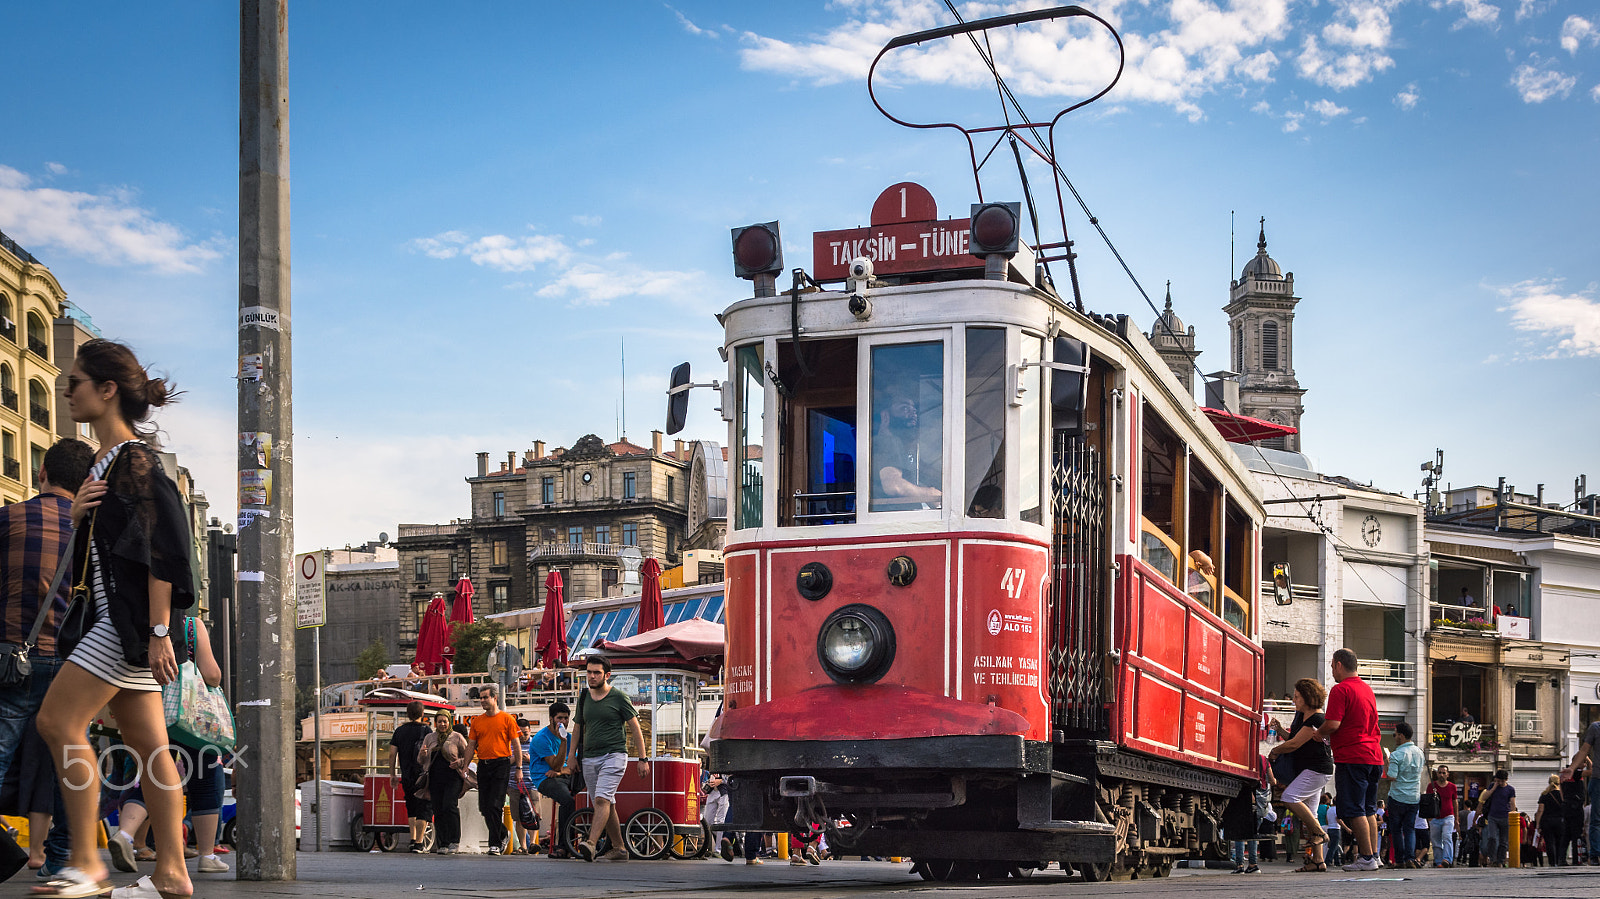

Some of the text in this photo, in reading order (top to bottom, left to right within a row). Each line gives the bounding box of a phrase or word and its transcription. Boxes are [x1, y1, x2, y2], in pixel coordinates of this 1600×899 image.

[898, 187, 907, 218] 1
[829, 231, 897, 266] TAKSİM
[919, 226, 971, 258] TÜNE
[244, 311, 277, 324] GÜNLÜK
[328, 581, 362, 593] AK-KA
[1000, 567, 1026, 599] 47
[1003, 622, 1020, 632] ALO
[1020, 624, 1032, 634] 153
[973, 655, 1038, 670] ASILMAK YASAK
[973, 672, 986, 685] VE
